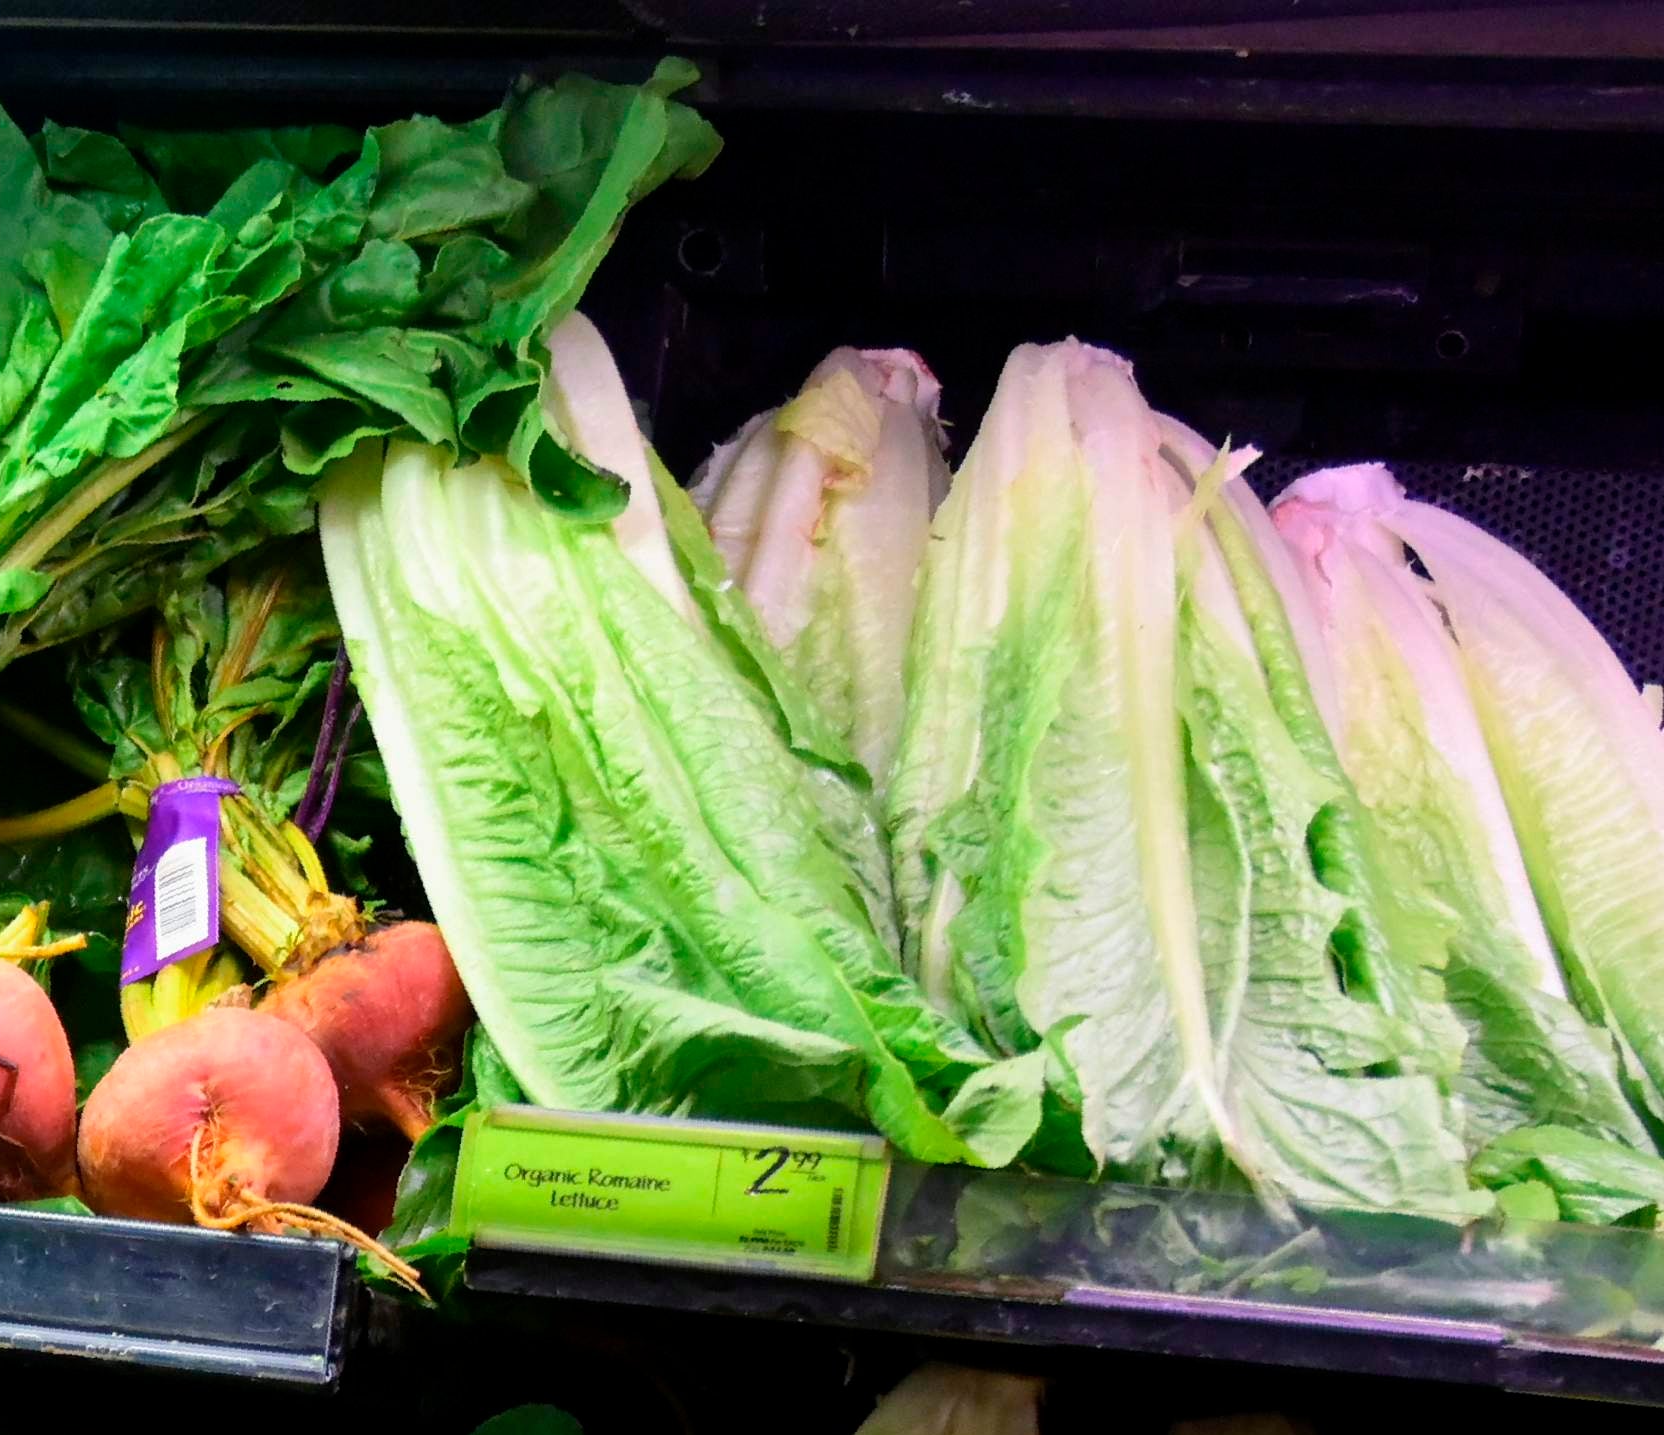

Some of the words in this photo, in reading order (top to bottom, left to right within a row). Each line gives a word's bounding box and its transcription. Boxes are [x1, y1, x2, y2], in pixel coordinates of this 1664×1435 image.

[504, 1163, 583, 1188] Organic
[587, 1168, 672, 1192] Romaine
[550, 1190, 620, 1211] Lettuce
